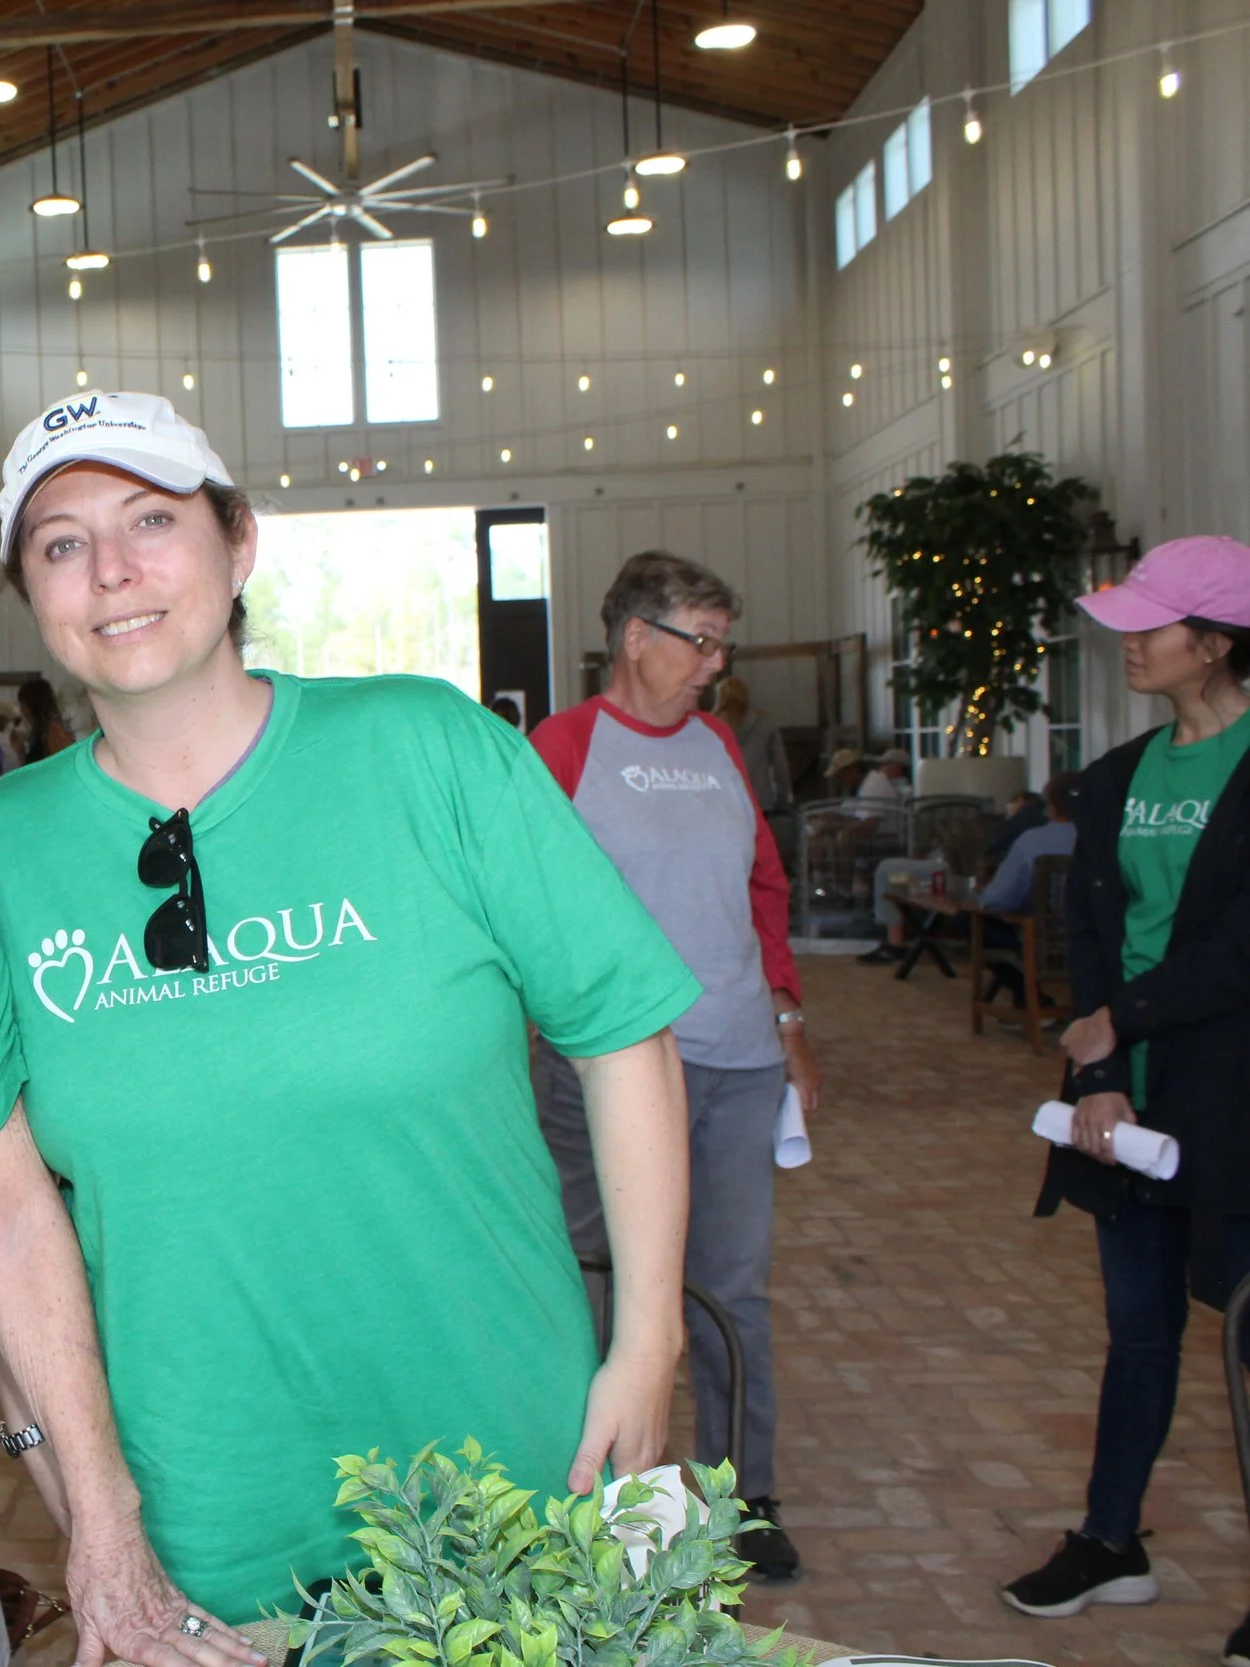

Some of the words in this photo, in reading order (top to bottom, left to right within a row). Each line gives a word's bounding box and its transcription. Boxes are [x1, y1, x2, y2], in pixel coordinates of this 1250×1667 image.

[43, 396, 97, 431] GW
[27, 441, 49, 462] George
[48, 422, 97, 442] Washington
[98, 420, 142, 430] University
[1128, 799, 1210, 829] ALAQ
[95, 897, 378, 985] AQUA
[94, 981, 186, 1011] ANIMAL
[191, 962, 281, 996] REFUGE
